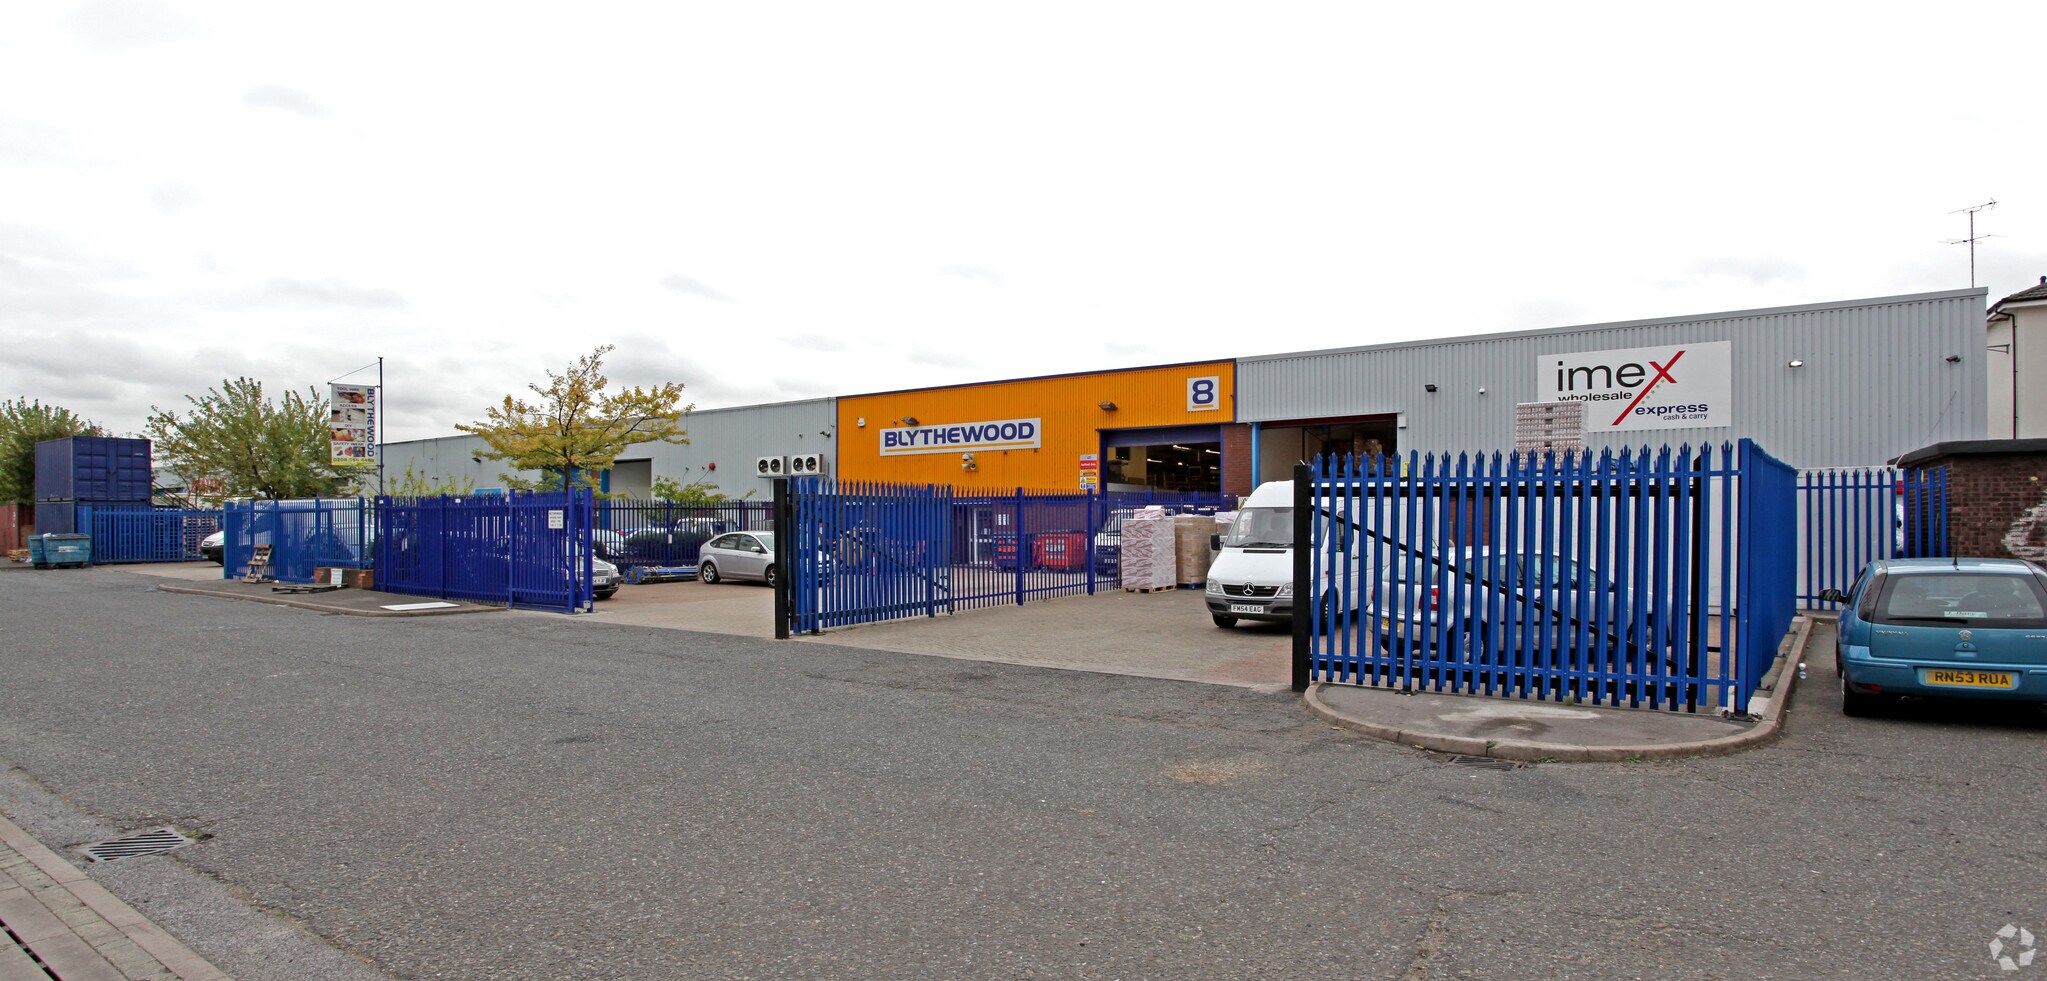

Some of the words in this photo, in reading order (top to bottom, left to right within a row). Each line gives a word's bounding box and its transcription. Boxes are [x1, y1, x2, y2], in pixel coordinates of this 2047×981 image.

[1192, 379, 1214, 404] 8
[1558, 350, 1686, 425] imex
[1558, 391, 1633, 402] wholesale
[1635, 404, 1709, 417] express
[1689, 412, 1709, 421] carry
[367, 388, 375, 457] BLYTHEWOOD
[884, 422, 1035, 448] BLYTHEWOOD
[1934, 671, 1975, 684] RN53
[1978, 673, 2009, 685] RUA
